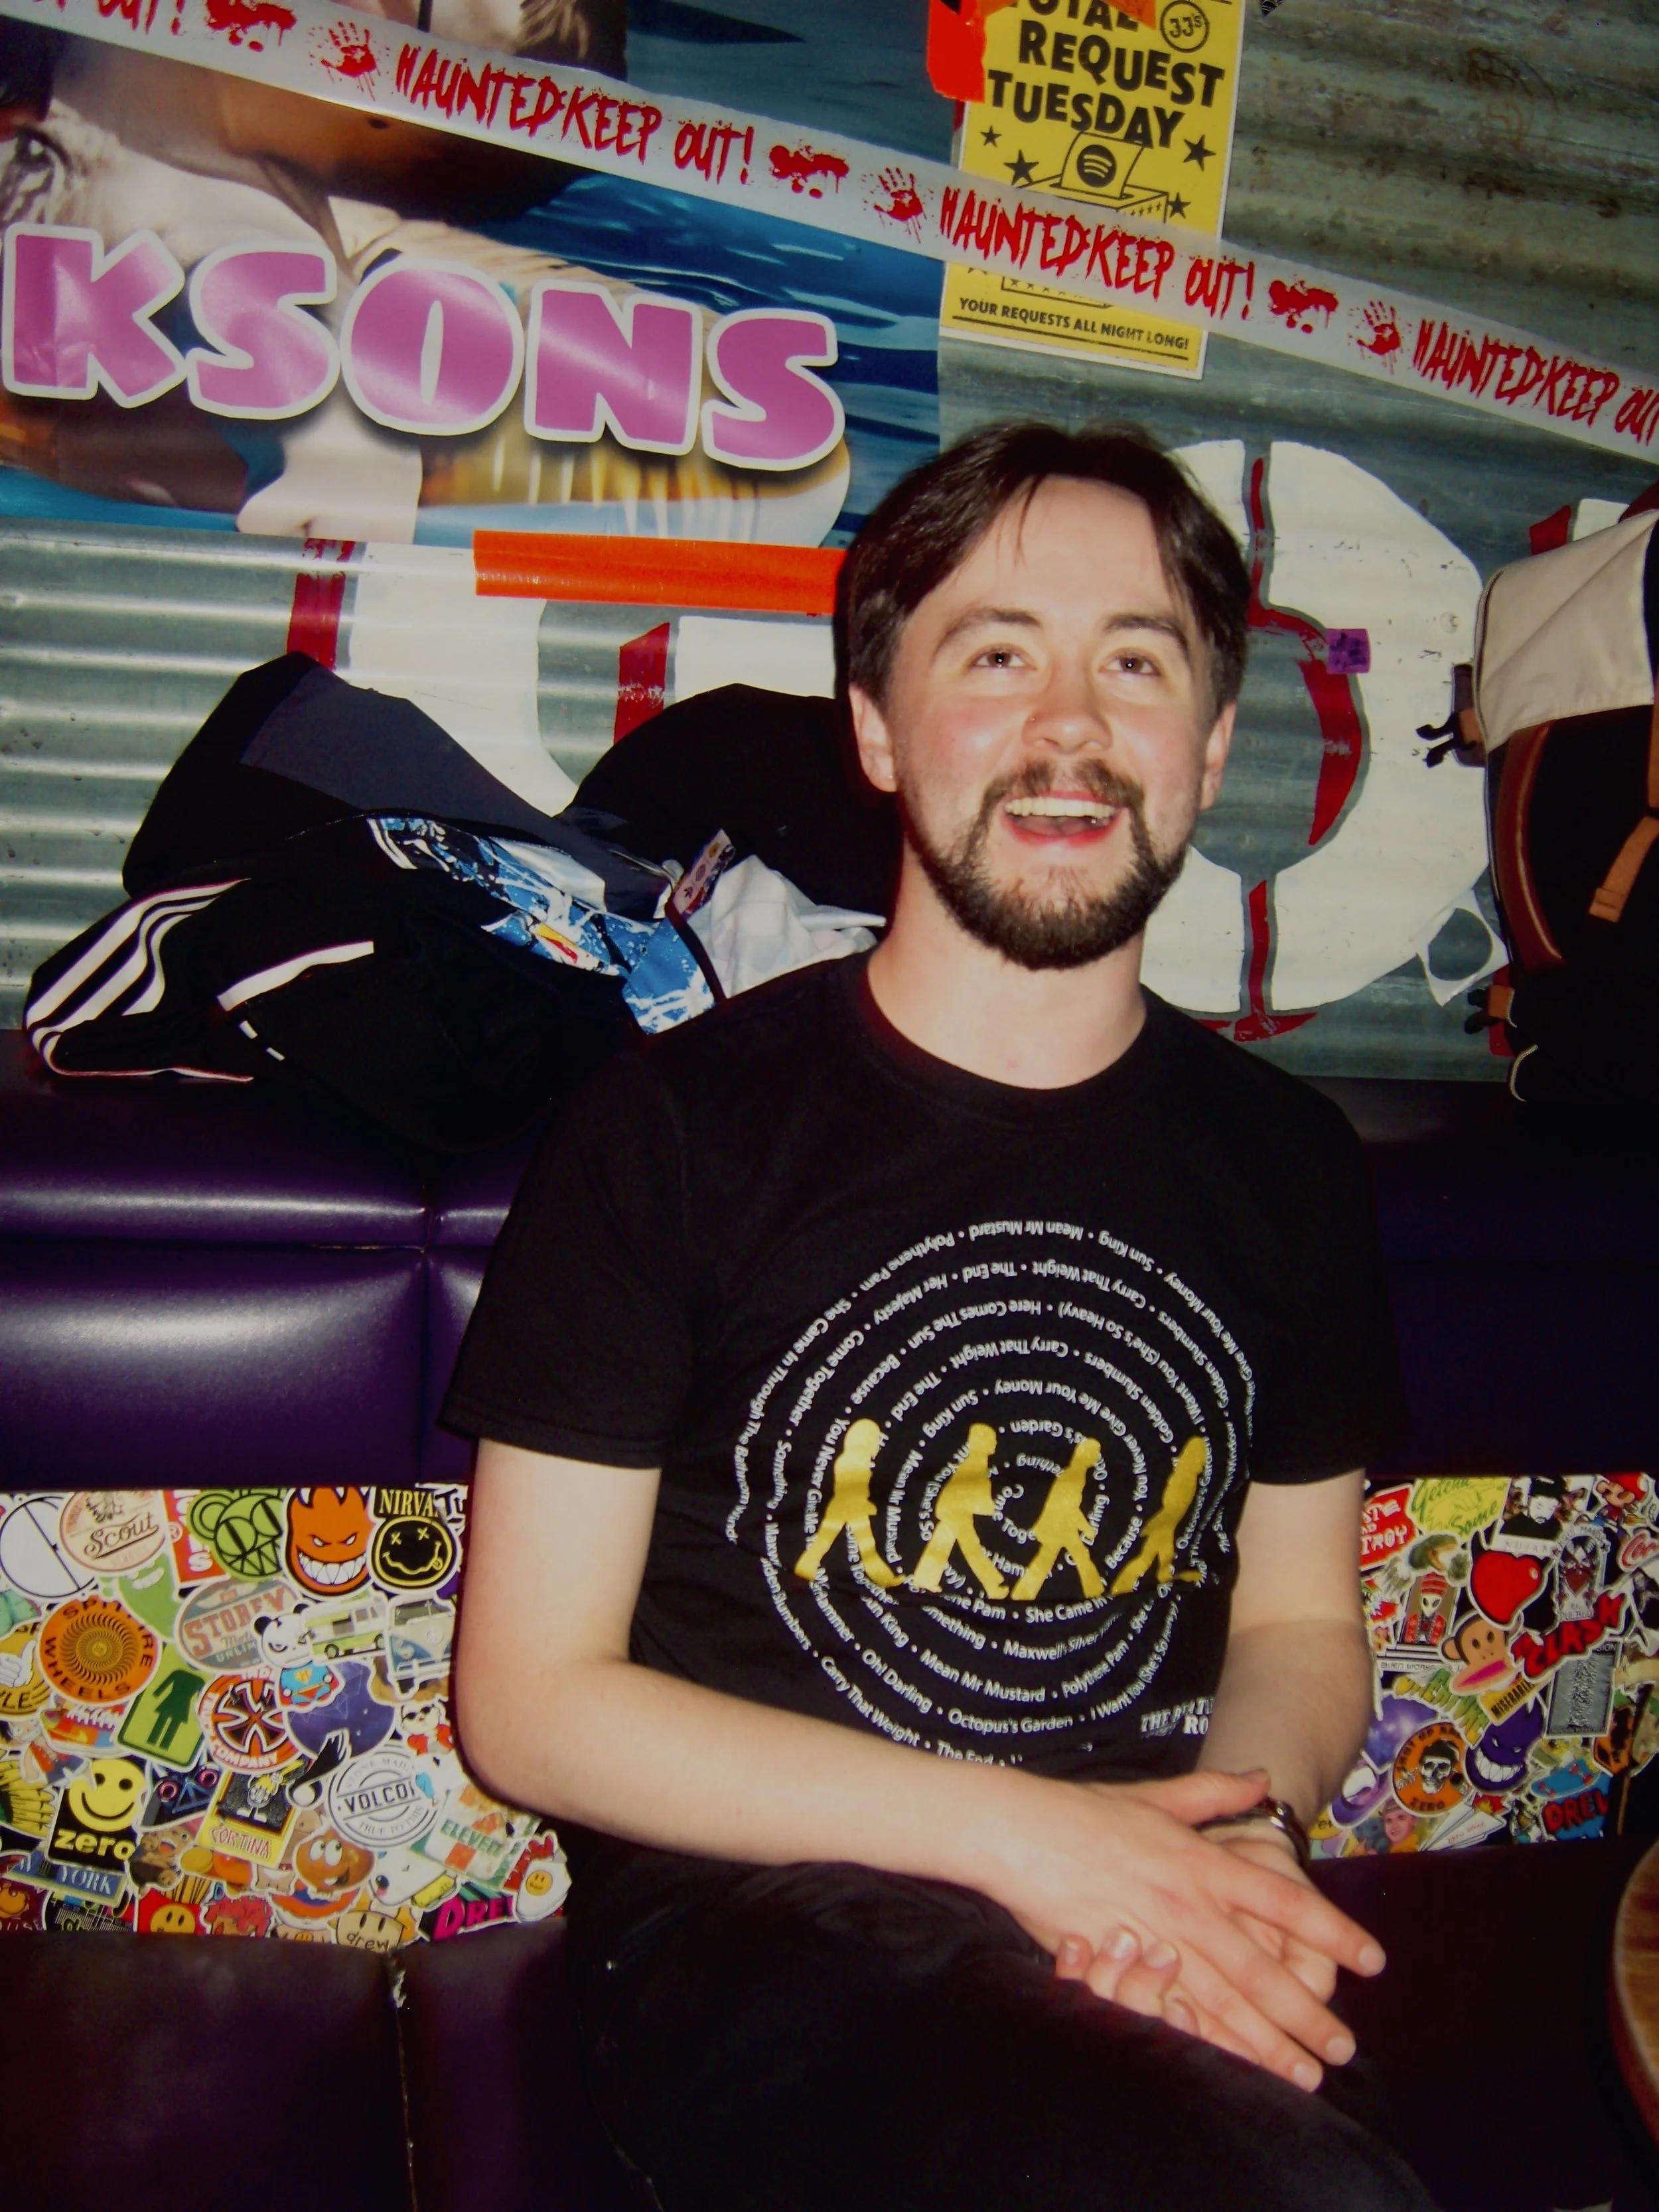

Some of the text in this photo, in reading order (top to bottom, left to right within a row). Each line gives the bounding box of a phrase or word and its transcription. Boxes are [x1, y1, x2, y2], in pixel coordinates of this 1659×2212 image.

[1019, 19, 1225, 107] REQUEST
[988, 69, 1185, 149] TUESDAY
[674, 119, 754, 185] OUT!
[1185, 256, 1255, 320] OUT!
[959, 297, 1189, 350] YOUR REQUESTS ALL NIGHT LONG!
[3, 222, 846, 472] KSONS
[969, 1221, 1084, 1241] Mean Mr Mustard
[859, 1232, 956, 1291] Polythene Pam
[1098, 1230, 1155, 1271] Sun King
[962, 1262, 1017, 1283] The End
[1031, 1259, 1147, 1309] Carry That Weight
[824, 1298, 851, 1321] She
[873, 1273, 948, 1325] Her Majesty
[1164, 1272, 1204, 1313] Money
[907, 1300, 1041, 1349] Here Comes The Sun
[1058, 1302, 1104, 1330] Heavy)
[1106, 1318, 1124, 1340] So
[793, 1318, 829, 1354] Came
[949, 1335, 1068, 1369] Carry That Weight
[1124, 1329, 1160, 1366] (She's
[1220, 1330, 1239, 1355] Me
[789, 1330, 864, 1427] Come Together
[1157, 1311, 1230, 1409] Golden Slumbers
[1157, 1359, 1179, 1388] You
[750, 1365, 788, 1419] Through
[849, 1353, 901, 1405] Because
[890, 1371, 942, 1422] The End
[995, 1378, 1043, 1397] Money
[1045, 1381, 1076, 1404] Your
[1082, 1351, 1173, 1443] Golden Slumbers
[922, 1389, 979, 1438] Sun King
[1078, 1392, 1102, 1415] Me
[739, 1420, 761, 1445] The
[1010, 1419, 1063, 1436] Garden
[1100, 1408, 1127, 1437] Give
[810, 1443, 836, 1489] Never
[895, 1449, 923, 1487] Mean
[1122, 1433, 1147, 1474] Never
[891, 1487, 906, 1505] Mr
[992, 1484, 1024, 1521] Come
[1132, 1475, 1149, 1502] You
[84, 1511, 160, 1559] Scout
[918, 1521, 934, 1542] So
[1104, 1515, 1143, 1569] Because
[972, 1598, 1007, 1620] Pam
[1025, 1606, 1053, 1624] She
[1055, 1600, 1094, 1620] Came
[879, 1611, 910, 1648] King
[862, 1648, 932, 1714] Oh! Darling
[919, 1649, 1045, 1702] Mean Mr Mustard
[1061, 1639, 1128, 1698] Polythene Pam
[820, 1657, 920, 1748] Carry That Weight
[948, 1707, 1073, 1735] Octopus's Garden
[1096, 1696, 1130, 1718] Want
[54, 1829, 136, 1862] zero
[210, 1827, 271, 1861] CORTINA
[60, 1870, 111, 1895] YORK
